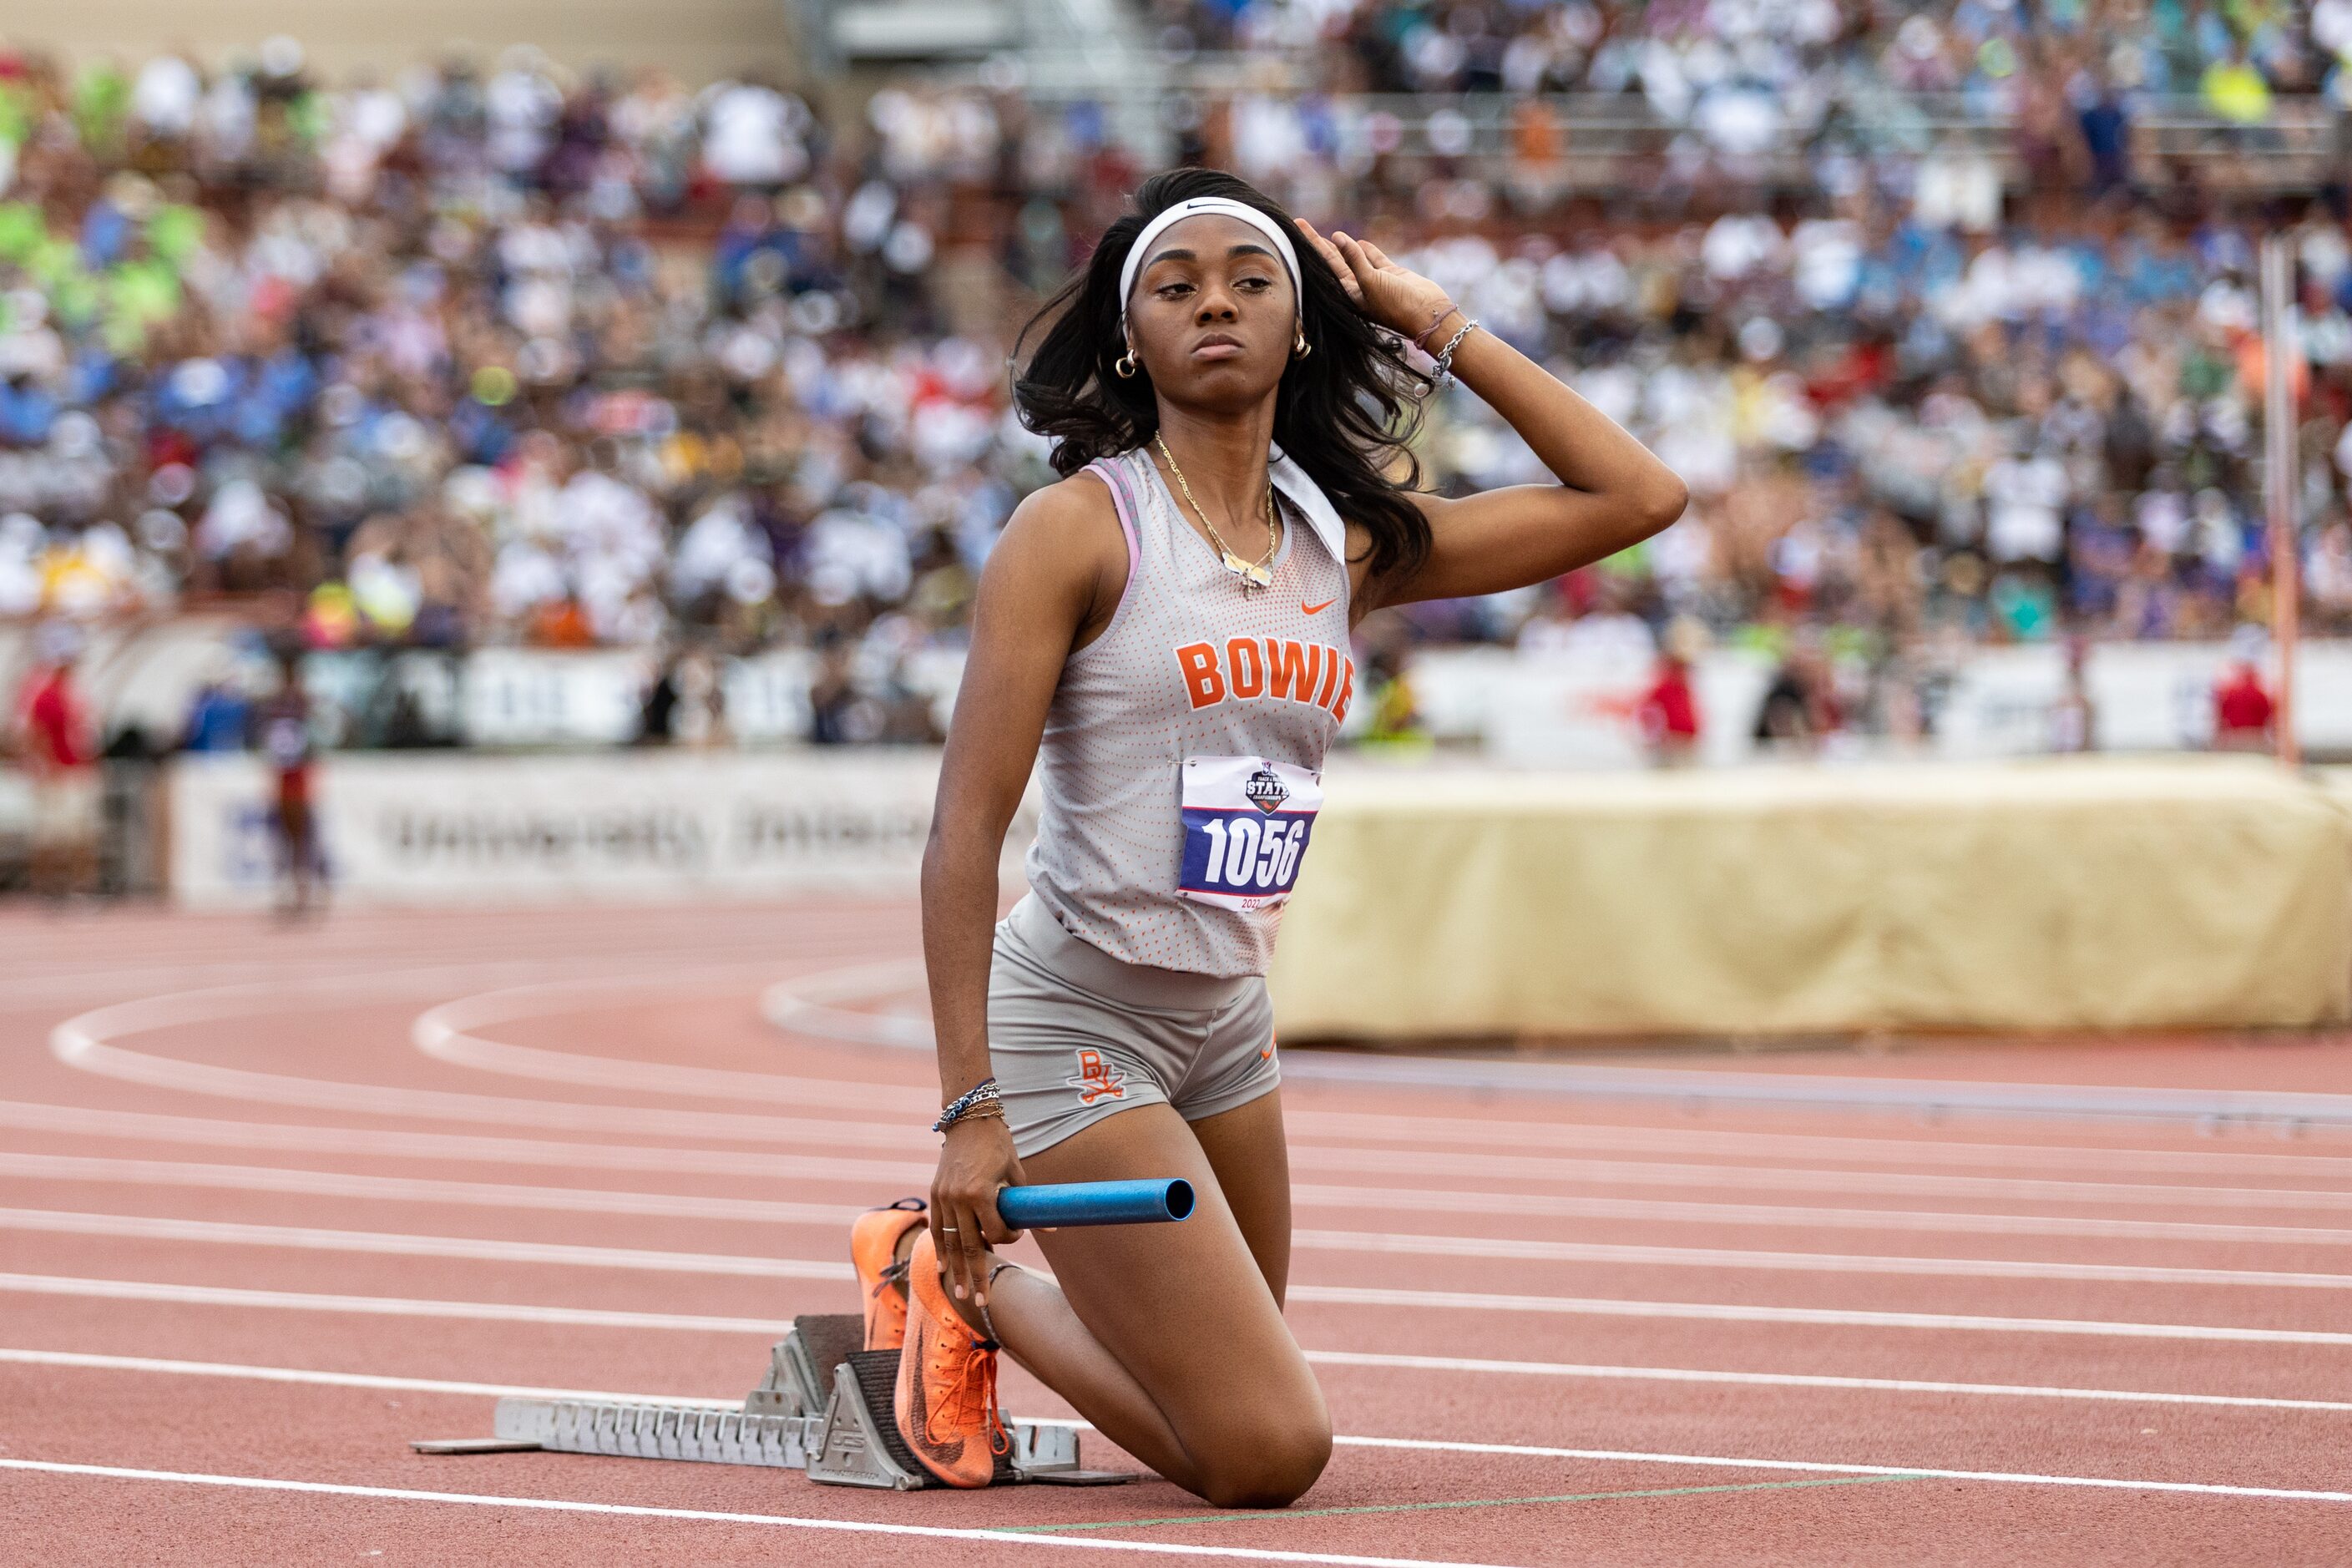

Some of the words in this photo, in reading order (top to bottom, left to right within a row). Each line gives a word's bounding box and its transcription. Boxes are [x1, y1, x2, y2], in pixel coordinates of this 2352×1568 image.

[1173, 635, 1355, 726] BOWIE
[1247, 781, 1289, 795] STATE
[1201, 817, 1305, 888] 1056
